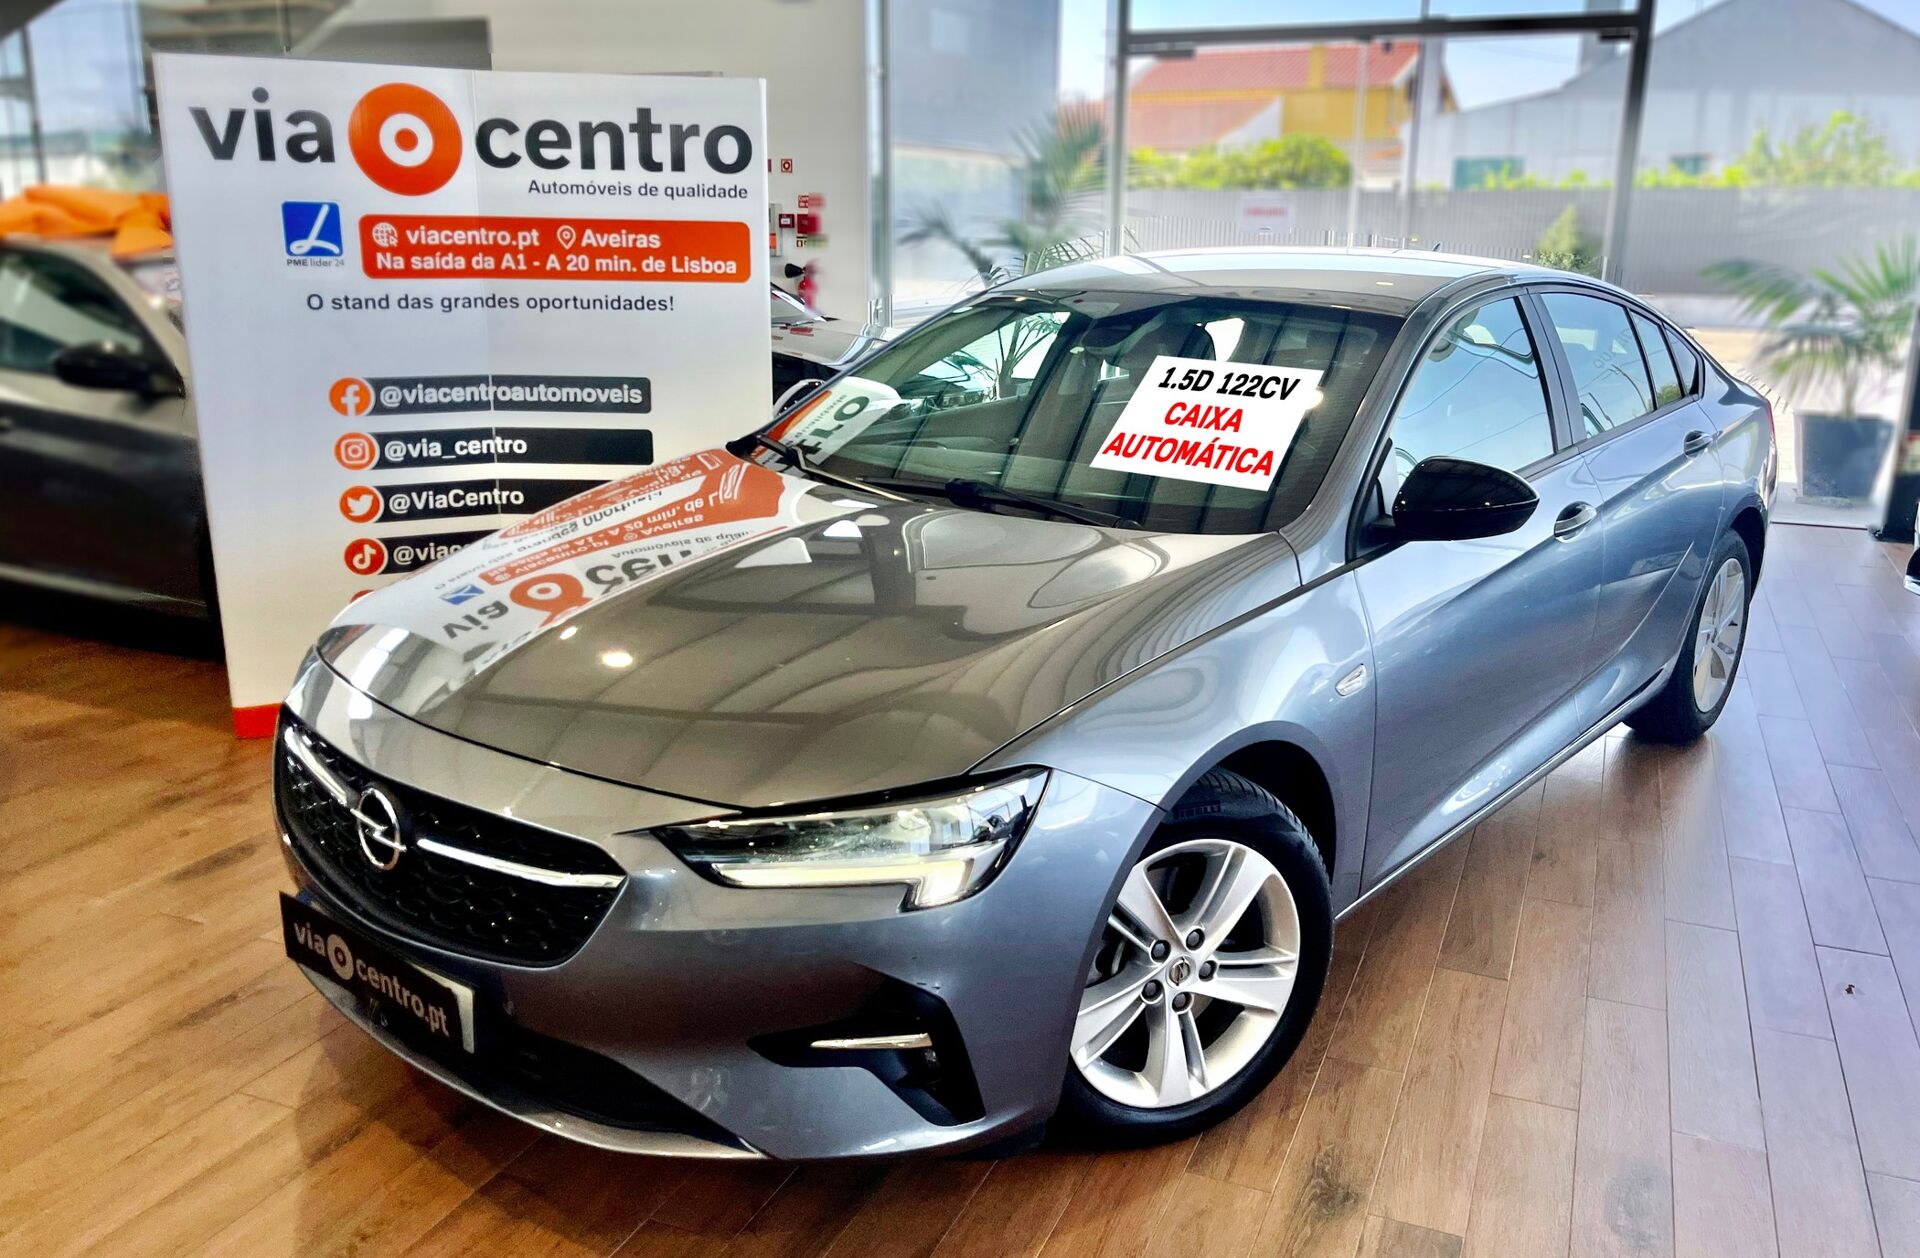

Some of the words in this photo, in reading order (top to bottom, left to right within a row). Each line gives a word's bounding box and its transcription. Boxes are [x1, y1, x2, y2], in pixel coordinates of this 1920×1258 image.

[188, 86, 336, 163] via
[475, 107, 753, 174] centro
[528, 180, 632, 197] Automóveis
[638, 182, 659, 198] de
[664, 181, 748, 200] qualidade
[406, 227, 540, 249] viacentro.pt
[581, 230, 660, 248] Aveiras
[286, 258, 308, 267] PME
[376, 253, 405, 270] Na
[410, 251, 466, 271] saída
[472, 252, 496, 271] da
[500, 254, 526, 270] A1
[546, 254, 561, 271] A
[566, 255, 590, 272] 20
[595, 255, 637, 273] min.
[642, 256, 666, 273] de
[671, 257, 737, 274] Lisboa
[307, 293, 324, 311] O
[331, 293, 390, 311] stand
[396, 294, 433, 311] das
[441, 293, 519, 314] grandes
[526, 294, 675, 314] oportunidades!
[380, 383, 642, 409] @viacentroautomoveis
[384, 434, 528, 462] @via_centro
[389, 486, 525, 513] @ViaCentro
[294, 922, 326, 957] via
[355, 958, 450, 1039] centro.pt
